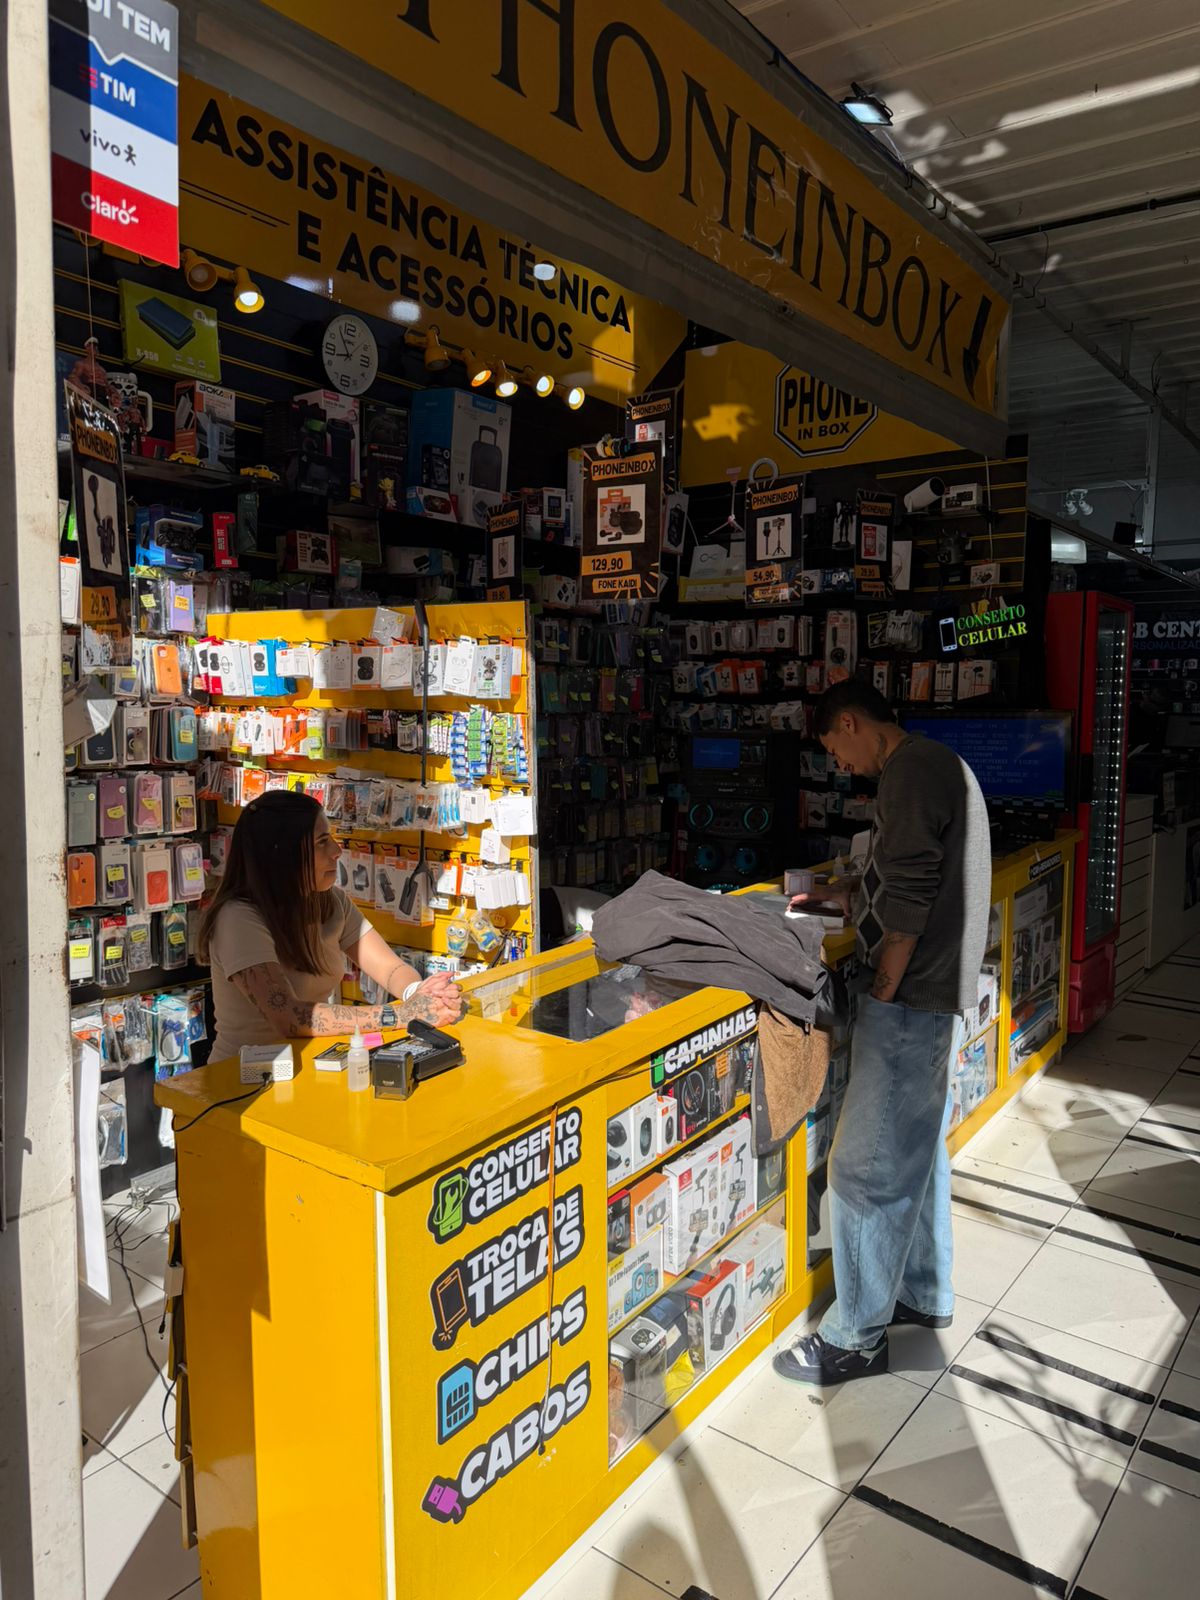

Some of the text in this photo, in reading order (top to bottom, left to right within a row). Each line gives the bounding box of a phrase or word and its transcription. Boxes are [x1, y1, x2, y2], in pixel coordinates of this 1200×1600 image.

[117, 2, 170, 53] TEM
[100, 72, 136, 108] TIM
[80, 128, 121, 156] vivo
[81, 192, 132, 225] Claro
[397, 0, 957, 379] HONEINBOX
[191, 98, 631, 333] ASSISTÊNCIA TÉCNICA
[297, 210, 574, 360] E ACESSÓRIOS
[798, 421, 850, 440] IN BOX
[592, 458, 656, 477] PHONEINBOX
[753, 490, 798, 506] PHONEINBOX
[591, 557, 624, 572] 129,90
[598, 577, 637, 590] FONE KAIDI
[957, 604, 1025, 630] CONSERTO
[958, 621, 1028, 647] CELULAR
[664, 1008, 757, 1073] CAPINHAS
[469, 1112, 580, 1188] CONSERTO
[469, 1135, 579, 1217] CELULAR
[467, 1214, 547, 1281] TROCA
[554, 1192, 579, 1228] DE
[468, 1216, 581, 1319] TELAS
[475, 1290, 585, 1400] CHIPS
[461, 1368, 588, 1499] CABOS
